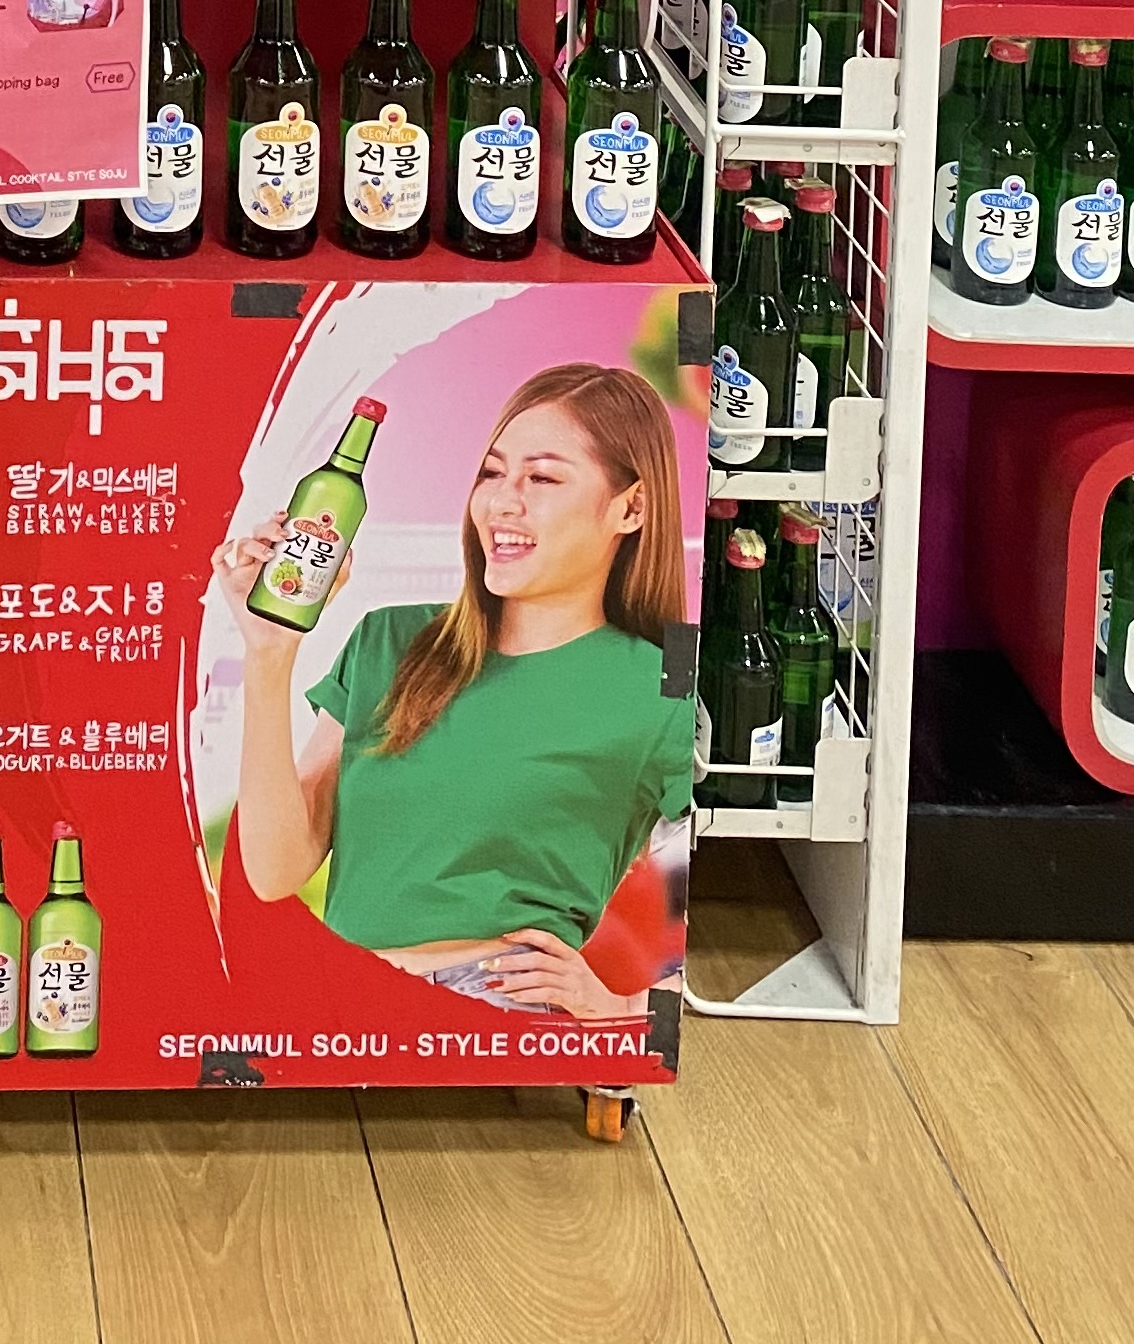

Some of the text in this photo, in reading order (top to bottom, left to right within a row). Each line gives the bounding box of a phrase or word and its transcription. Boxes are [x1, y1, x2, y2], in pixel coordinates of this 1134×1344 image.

[35, 75, 60, 92] bag
[93, 71, 125, 85] Free
[147, 128, 191, 143] EONMUL
[361, 125, 414, 143] SEONMUL
[478, 130, 533, 145] SEONMUL
[591, 134, 647, 150] SEONMUL
[99, 168, 128, 180] SOJU
[7, 501, 177, 520] STRAW MIXED
[6, 513, 175, 535] BERRY & BERRY
[78, 636, 93, 651] &
[95, 624, 163, 644] GRAPE
[95, 643, 163, 663] FRUIT
[58, 726, 77, 745] &
[81, 719, 170, 752] 블루베리
[159, 1034, 302, 1058] SEONMUL
[311, 1033, 388, 1057] SOJU
[417, 1033, 509, 1057] STYLE
